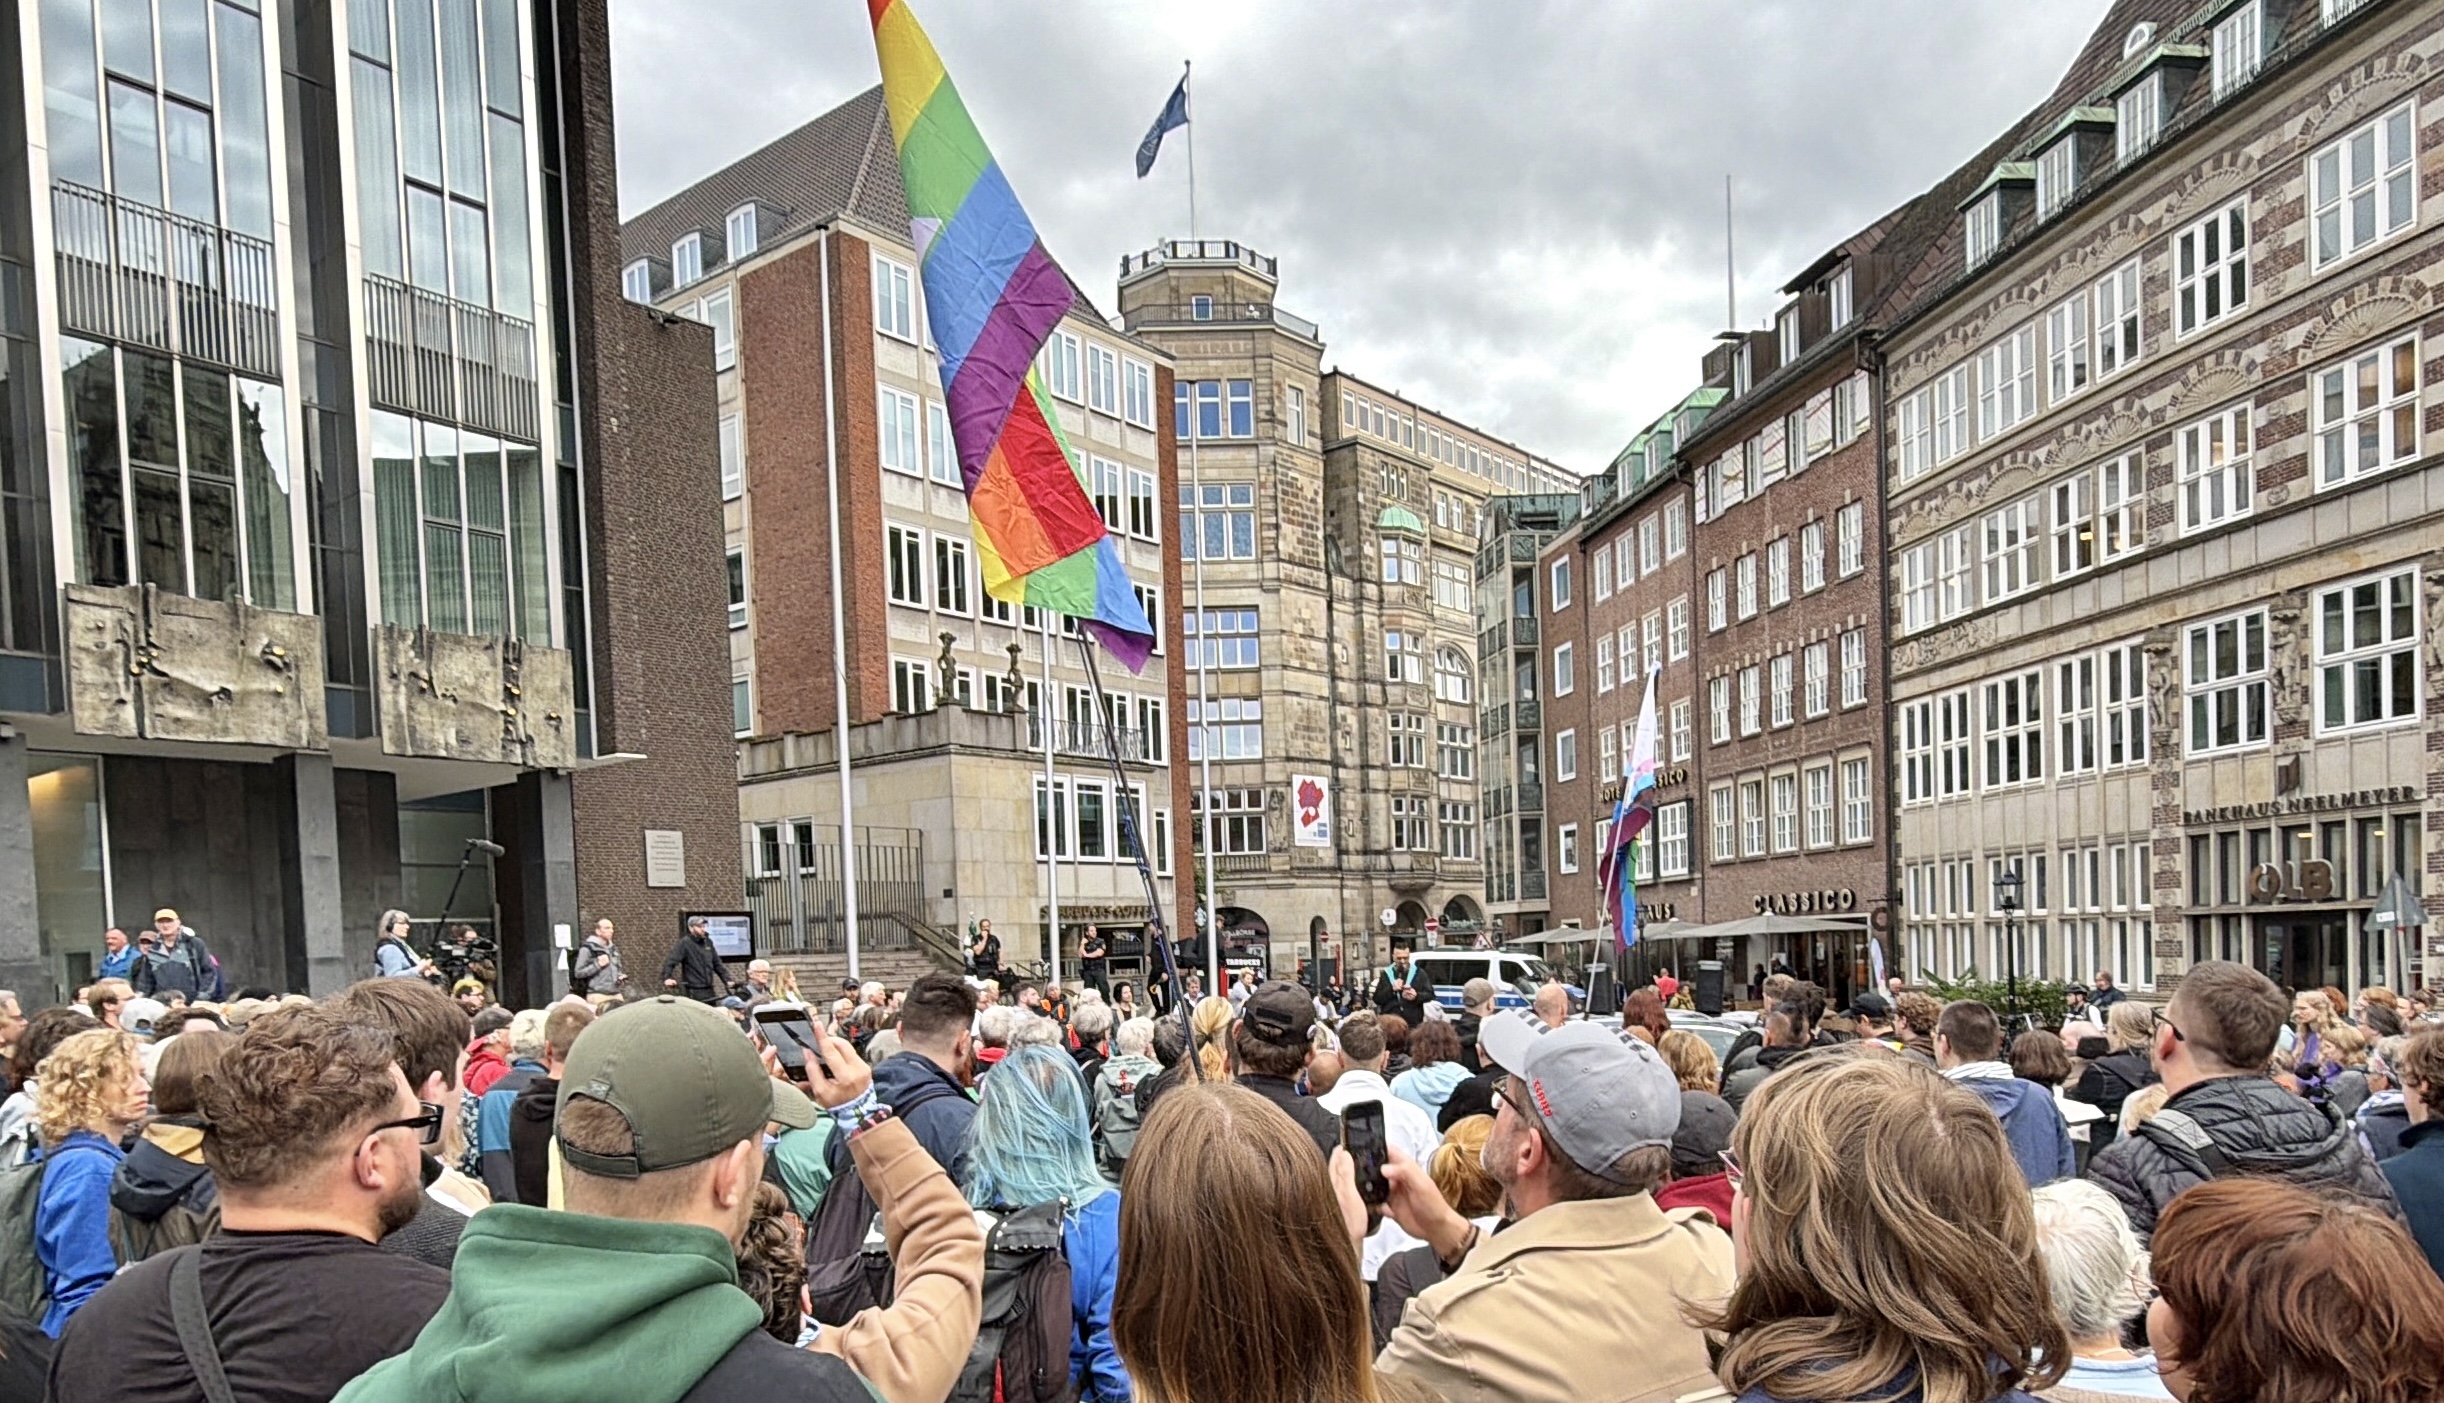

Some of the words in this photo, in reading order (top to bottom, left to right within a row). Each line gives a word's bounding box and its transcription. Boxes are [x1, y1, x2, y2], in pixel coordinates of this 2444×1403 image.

[1599, 786, 1621, 803] HOTE
[2183, 801, 2280, 823] BANKHAUS
[2289, 786, 2414, 813] NEELMEYER
[2250, 858, 2335, 901] OLB
[1753, 888, 1855, 914] CLASSICO
